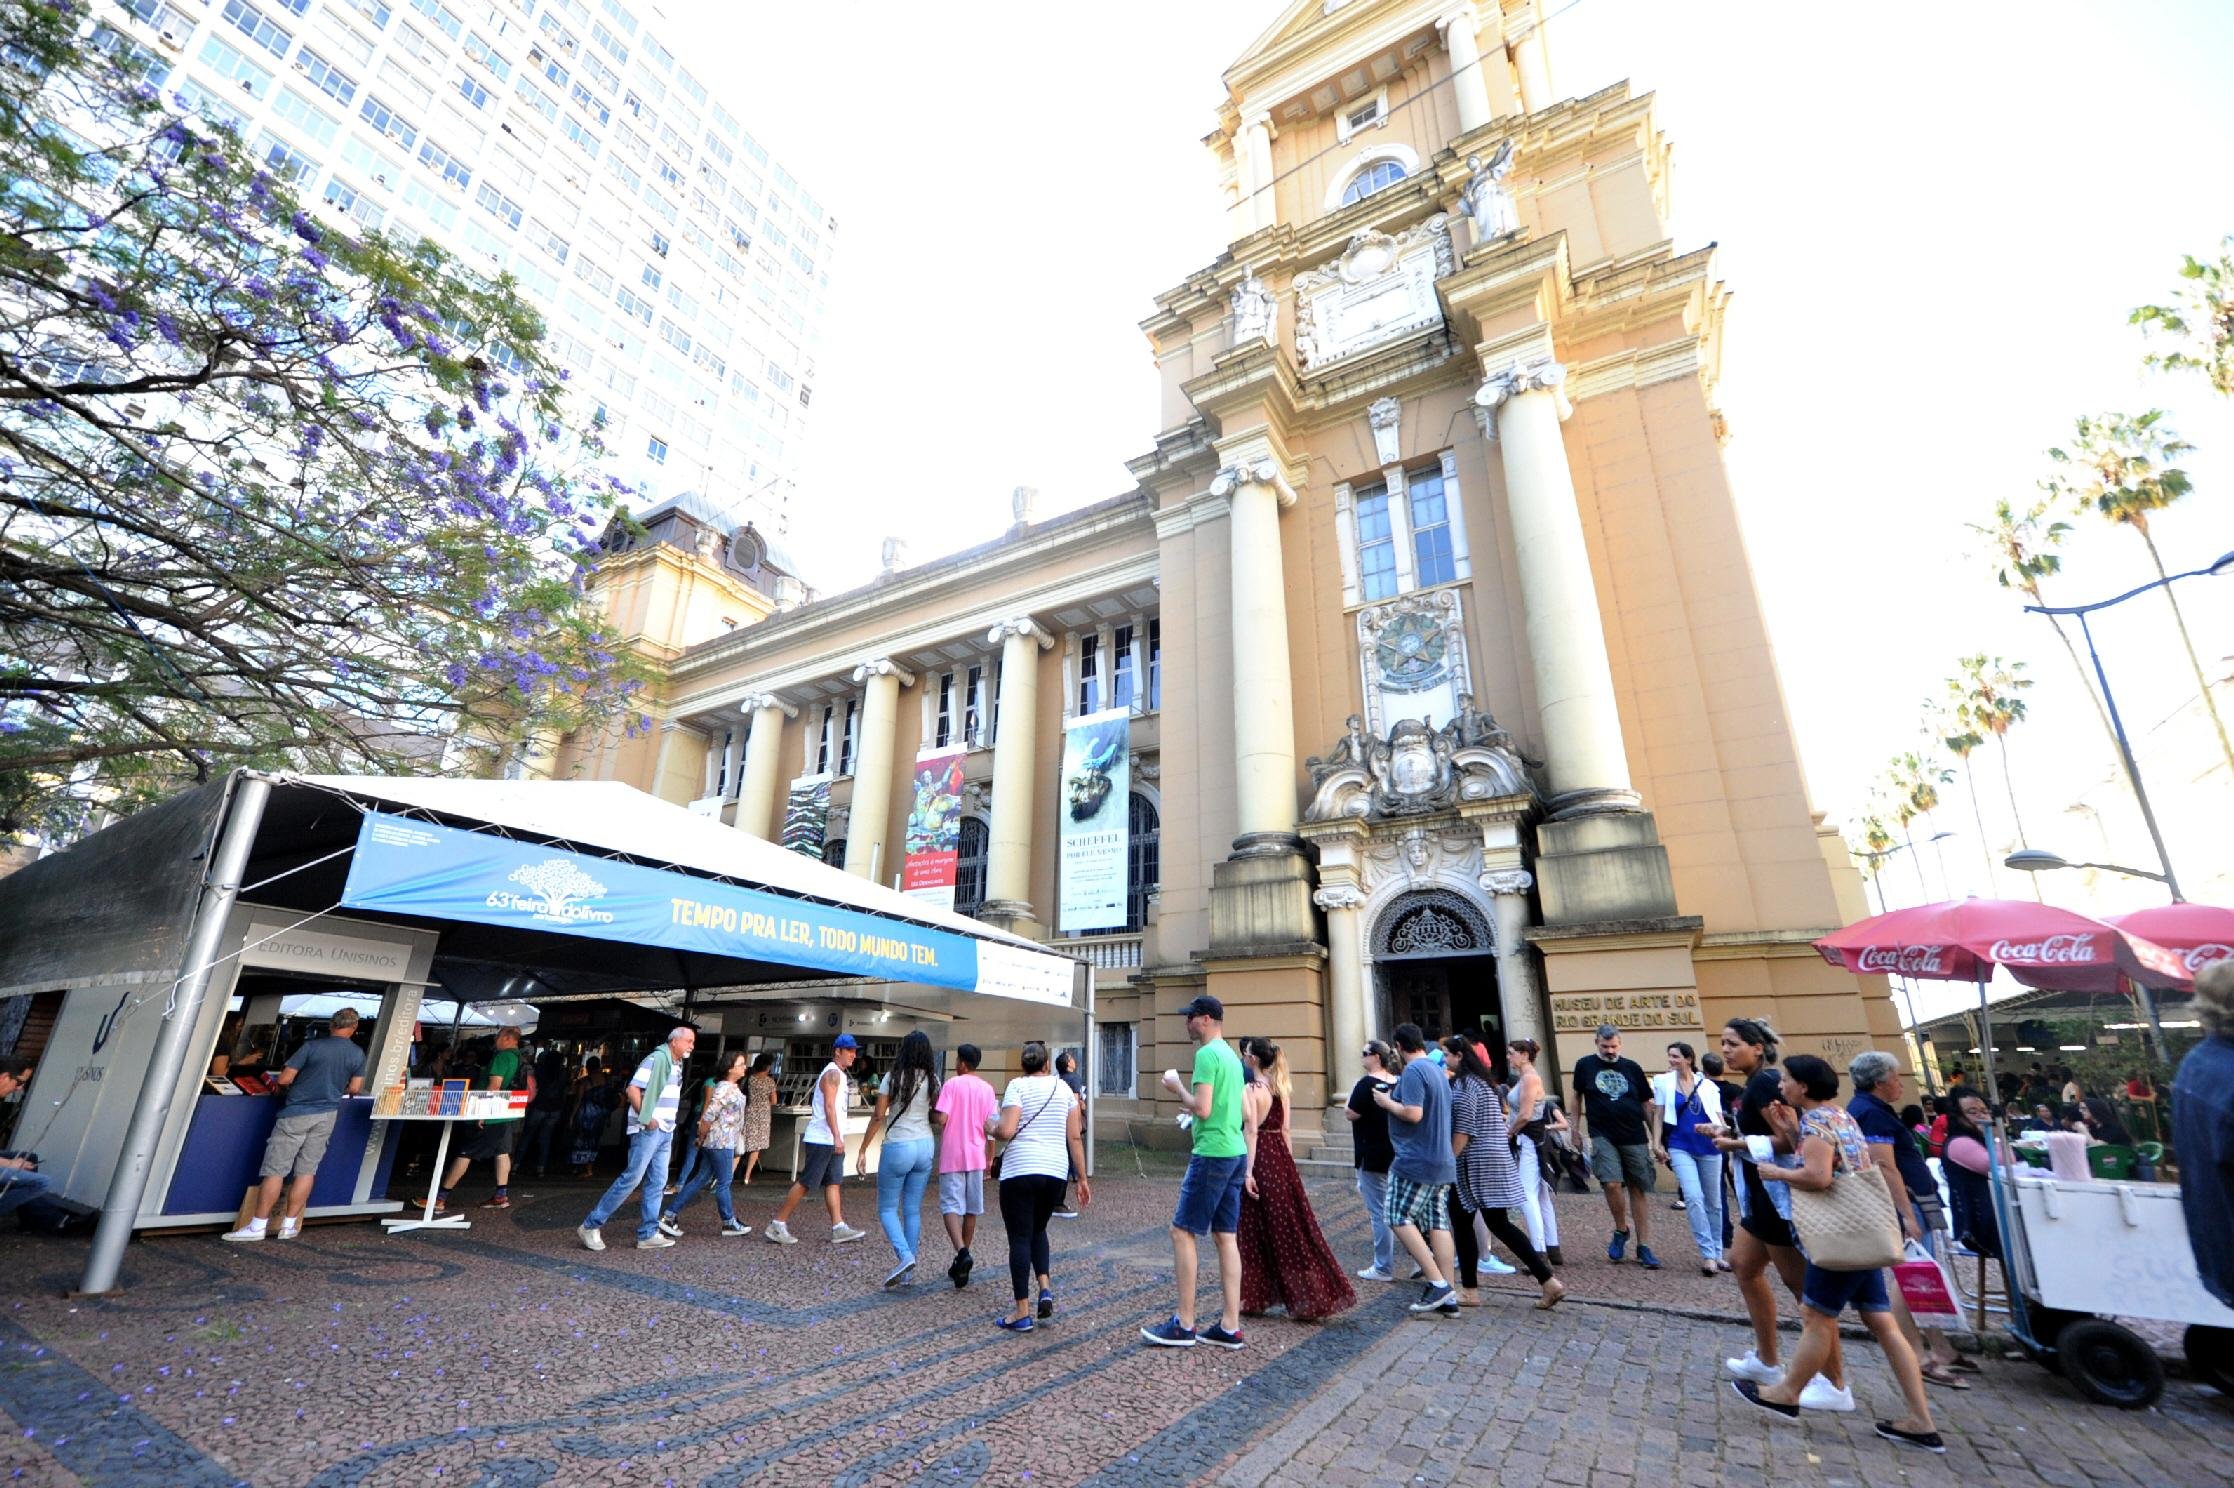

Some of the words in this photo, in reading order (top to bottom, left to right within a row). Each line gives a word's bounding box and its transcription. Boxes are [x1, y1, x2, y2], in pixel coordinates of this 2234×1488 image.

[1066, 833, 1121, 848] SCHEFFEL
[670, 897, 737, 933] TEMPO
[740, 911, 777, 939] PRA
[780, 917, 815, 949] LER,
[818, 925, 856, 953] TODO
[859, 933, 908, 961] MUNDO
[911, 943, 939, 967] TEM.
[258, 941, 323, 960] EDITORA
[331, 947, 398, 968] UNISINOS
[1989, 932, 2095, 963] Coca-Cola
[1553, 997, 1601, 1011] MUSEU
[1604, 996, 1625, 1010] DE
[1630, 994, 1671, 1009] ARTE
[1675, 993, 1697, 1008] DO
[1555, 1014, 1578, 1027] RIO
[1582, 1012, 1640, 1027] GRANDE
[1643, 1012, 1663, 1025] DO
[1667, 1011, 1700, 1025] SUL
[2112, 1253, 2192, 1283] SUC
